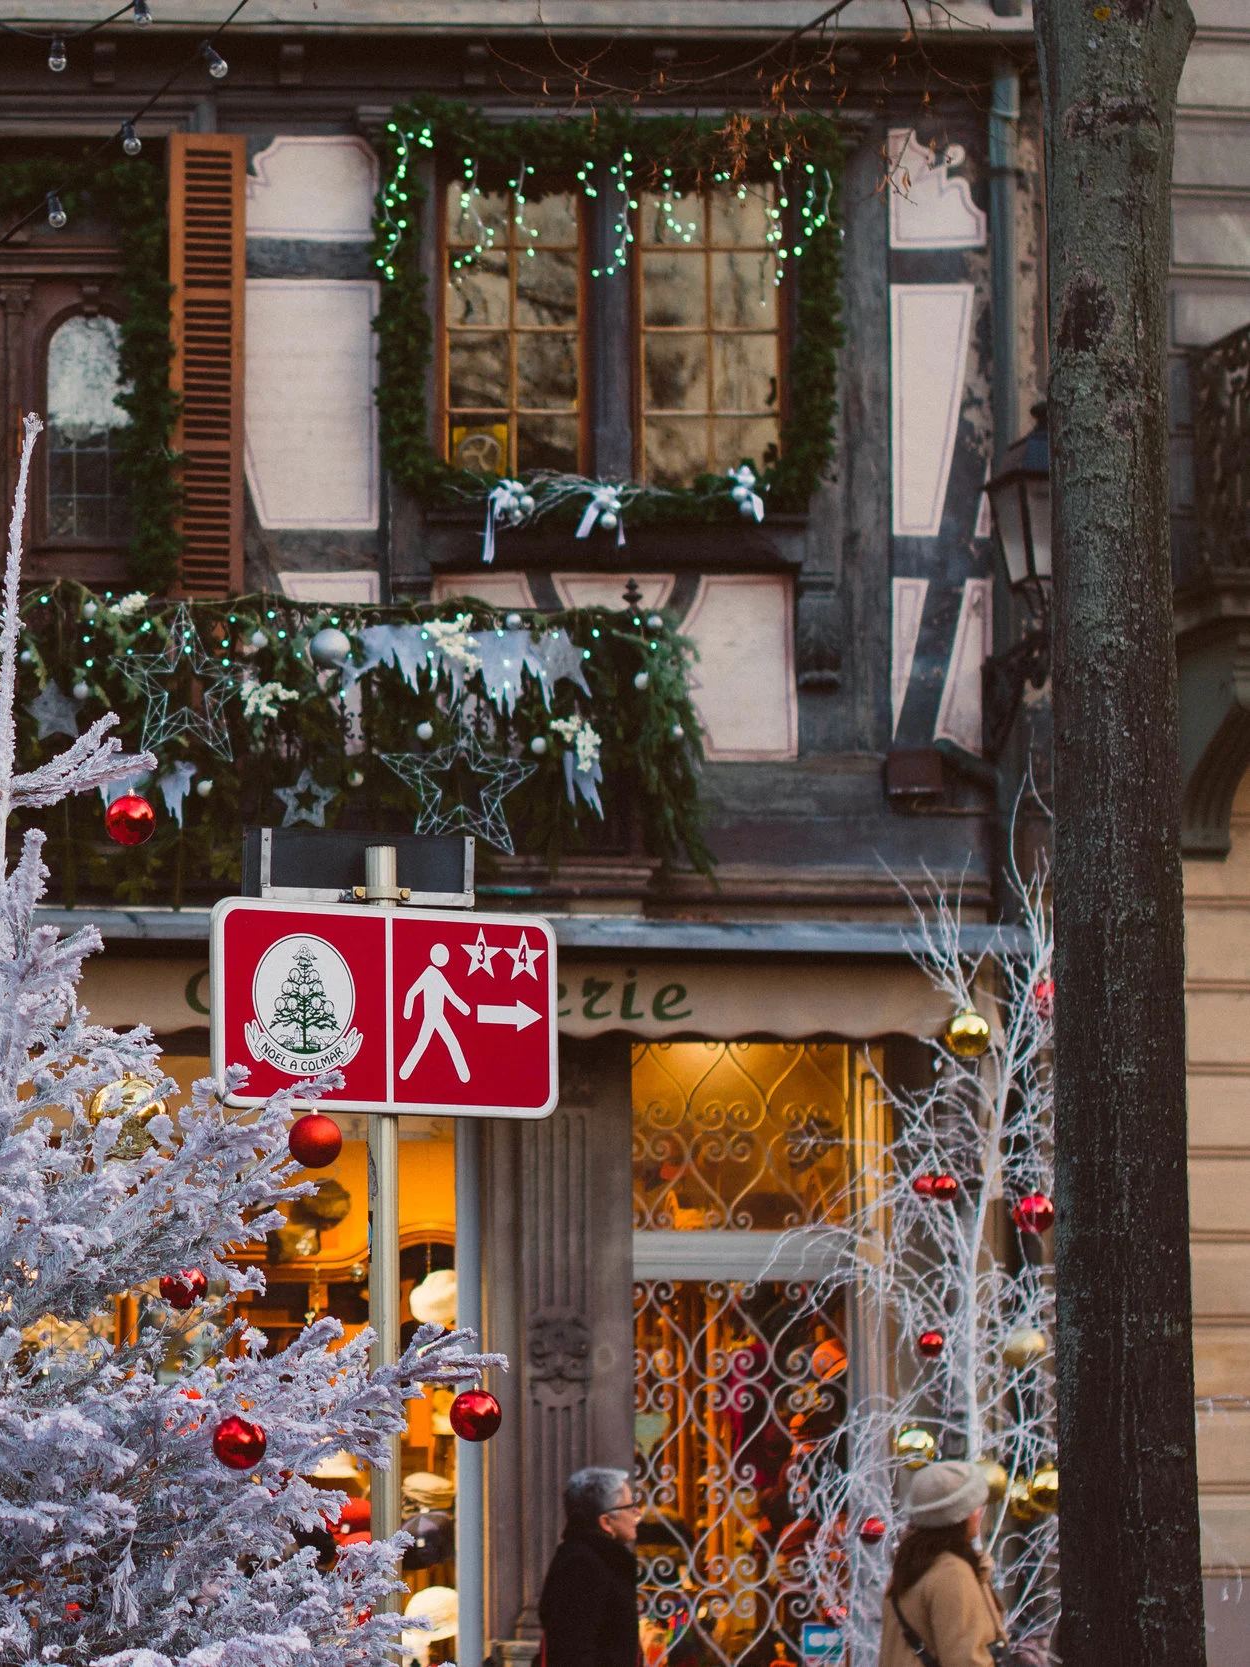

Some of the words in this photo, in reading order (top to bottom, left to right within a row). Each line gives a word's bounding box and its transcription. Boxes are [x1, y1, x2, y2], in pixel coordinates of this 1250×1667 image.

[477, 941, 486, 965] 3
[518, 944, 528, 968] 4
[260, 1042, 286, 1067] NOEL
[290, 1060, 298, 1070] A
[300, 1046, 345, 1072] COLMAR
